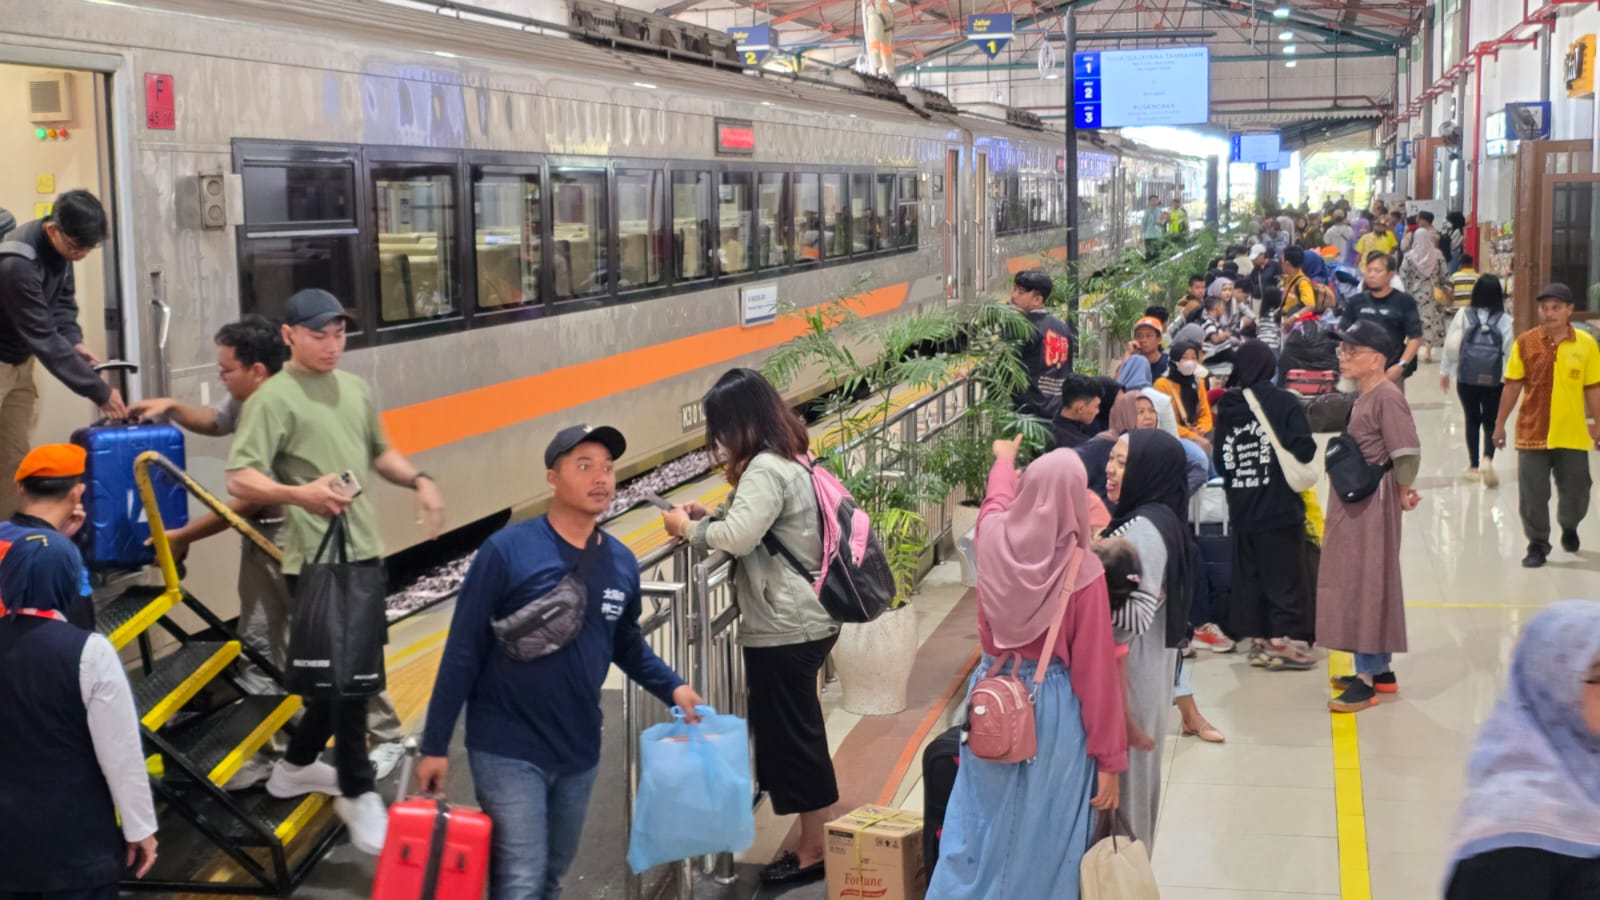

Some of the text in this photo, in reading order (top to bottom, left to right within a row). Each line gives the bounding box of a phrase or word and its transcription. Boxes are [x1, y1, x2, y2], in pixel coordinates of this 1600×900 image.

[973, 18, 991, 26] Jalur
[987, 41, 997, 54] 1
[745, 51, 757, 64] 2
[1086, 63, 1092, 73] 1
[156, 79, 164, 102] F
[1085, 87, 1093, 99] 2
[1085, 111, 1093, 123] 3
